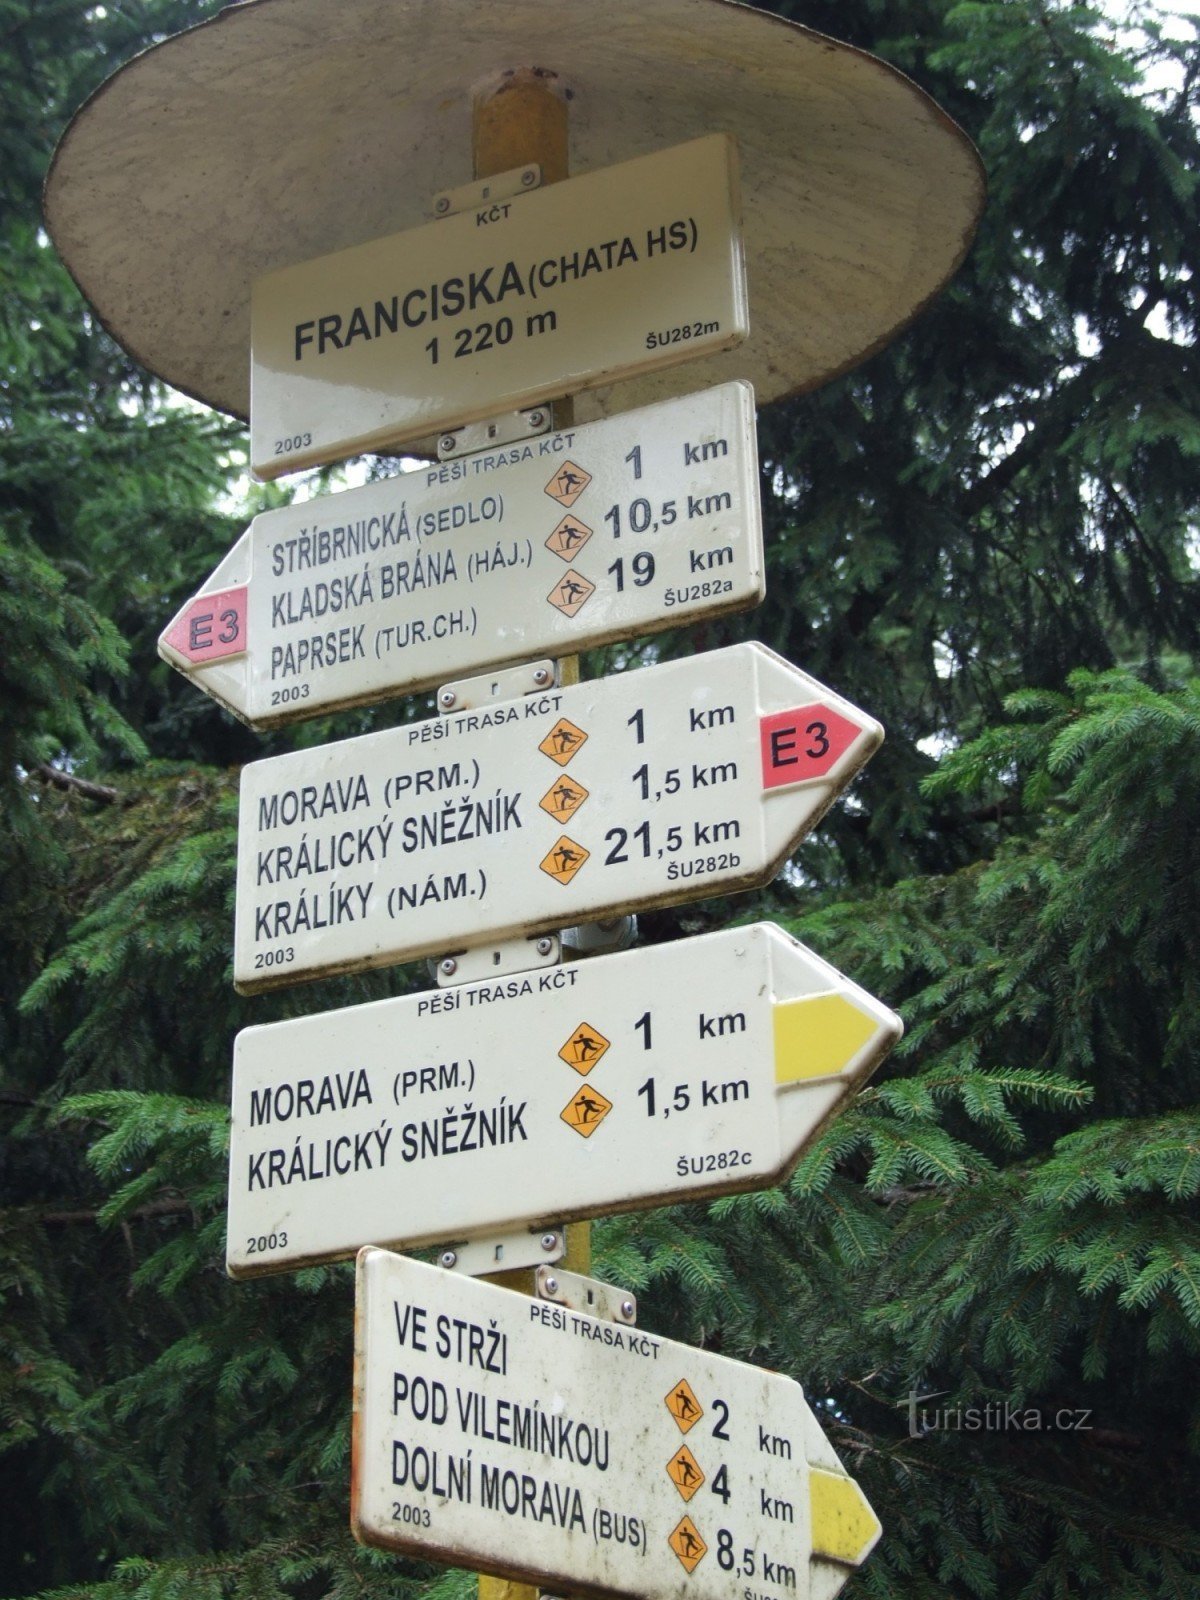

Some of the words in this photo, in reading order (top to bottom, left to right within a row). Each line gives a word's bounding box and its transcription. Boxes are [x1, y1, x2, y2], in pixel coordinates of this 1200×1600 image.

[476, 204, 511, 227] KČT
[647, 218, 698, 257] HS)
[527, 311, 557, 337] m
[646, 319, 720, 350] ŠU282m
[275, 433, 312, 455] 2003
[427, 460, 467, 487] PĚŠÍ
[471, 447, 534, 479] TRASA
[539, 433, 575, 460] KČT
[272, 502, 410, 577] STŘÍBRNICKÁ
[416, 495, 504, 543] (SEDLO)
[625, 445, 641, 479] 1
[684, 436, 728, 466] km
[271, 564, 374, 628] KLADSKÁ
[381, 549, 457, 594] BRÁNA
[467, 539, 532, 582] (HÁJ.)
[687, 491, 732, 519] km
[271, 629, 366, 680] PAPRSEK
[608, 551, 655, 591] 19
[689, 546, 734, 573] km
[664, 579, 733, 607] ŠU282a
[271, 684, 310, 706] 2003
[409, 719, 451, 746] PĚŠÍ
[455, 708, 519, 736] TRASA
[524, 695, 563, 718] KČT
[258, 775, 371, 831] MORAVA
[384, 760, 480, 809] (PRM.)
[627, 708, 645, 744] 1
[690, 704, 735, 732] km
[256, 817, 394, 886] KRÁLICKÝ
[402, 789, 522, 853] SNĚŽNÍK
[632, 764, 681, 801] 1,5
[692, 762, 738, 794] km
[254, 882, 374, 942] KRÁLÍKY
[387, 869, 487, 916] (NÁM.)
[604, 821, 682, 866] 21,5
[693, 815, 741, 846] km
[667, 853, 741, 881] ŠU282b
[255, 948, 294, 969] 2003
[417, 990, 461, 1017] PĚŠÍ
[466, 980, 533, 1007] TRASA
[538, 969, 579, 994] KČT
[250, 1069, 370, 1127] MORAVA
[393, 1059, 476, 1106] (PRM.)
[633, 1012, 653, 1050] 1
[699, 1011, 746, 1038] km
[247, 1120, 392, 1191] KRÁLICKÝ
[402, 1095, 527, 1162] SNĚŽNÍK
[638, 1077, 690, 1119] 1,5
[701, 1079, 750, 1106] km
[676, 1149, 752, 1178] ŠU282c
[246, 1232, 288, 1255] 2003
[530, 1304, 567, 1330] PĚŠÍ
[571, 1316, 624, 1348] TRASA
[629, 1334, 660, 1360] KČT
[392, 1301, 427, 1352] VE
[436, 1313, 507, 1375] STRŽI
[711, 1400, 730, 1441] 2
[759, 1425, 791, 1460] km
[392, 1372, 447, 1425] POD
[456, 1387, 609, 1472] VILEMÍNKOU
[711, 1464, 730, 1504] 4
[761, 1489, 794, 1523] km
[392, 1440, 472, 1502] DOLNÍ
[480, 1464, 587, 1534] MORAVA
[593, 1507, 648, 1556] (BUS)
[716, 1529, 756, 1579] 8,5
[763, 1554, 796, 1588] km
[392, 1502, 432, 1528] 2003
